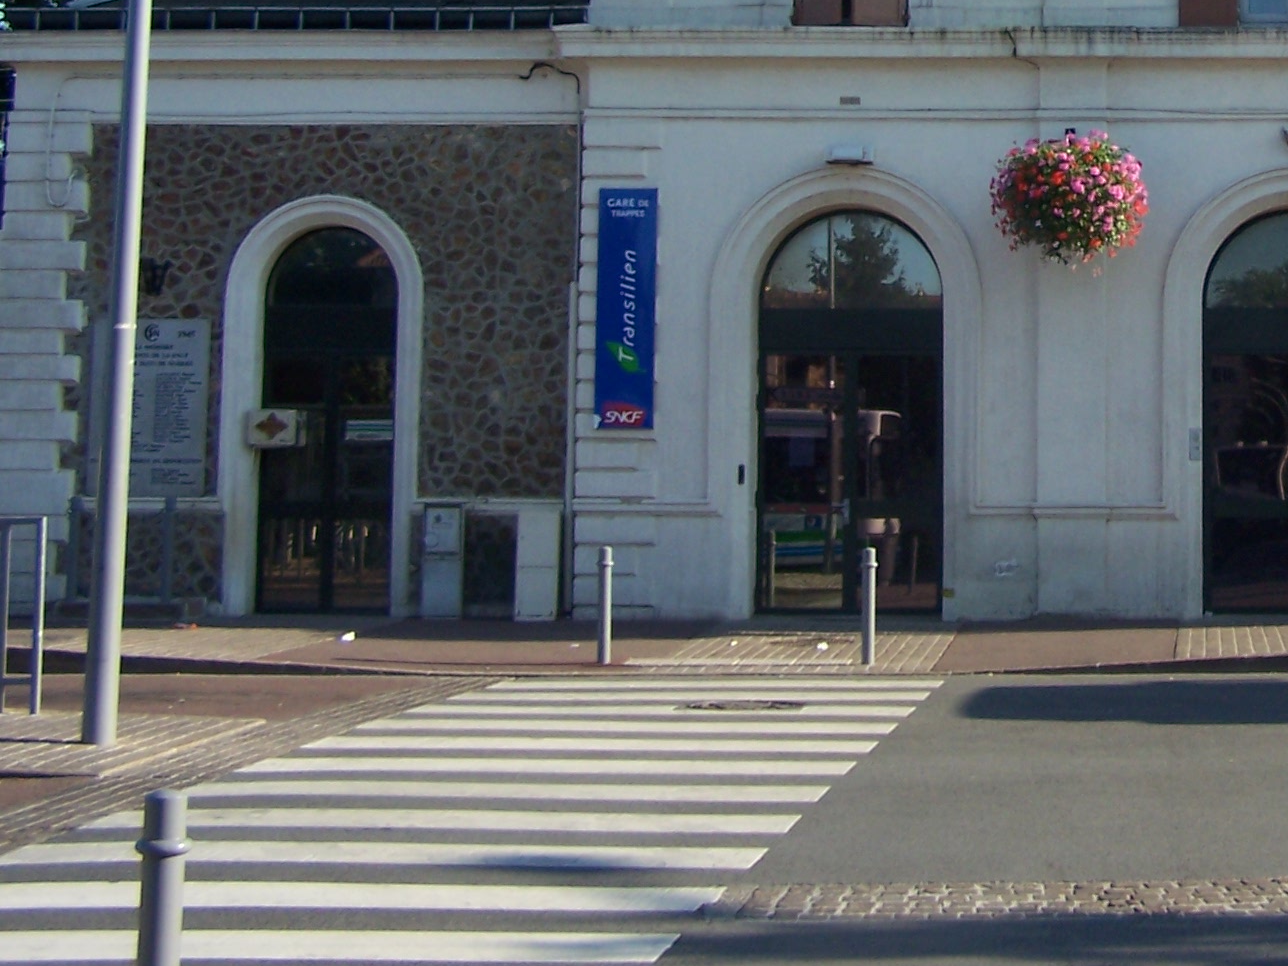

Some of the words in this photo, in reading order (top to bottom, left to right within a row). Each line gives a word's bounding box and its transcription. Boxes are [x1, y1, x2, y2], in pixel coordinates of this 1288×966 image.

[607, 198, 636, 207] GARE
[618, 249, 637, 362] Transilien
[604, 410, 643, 424] SNCF
